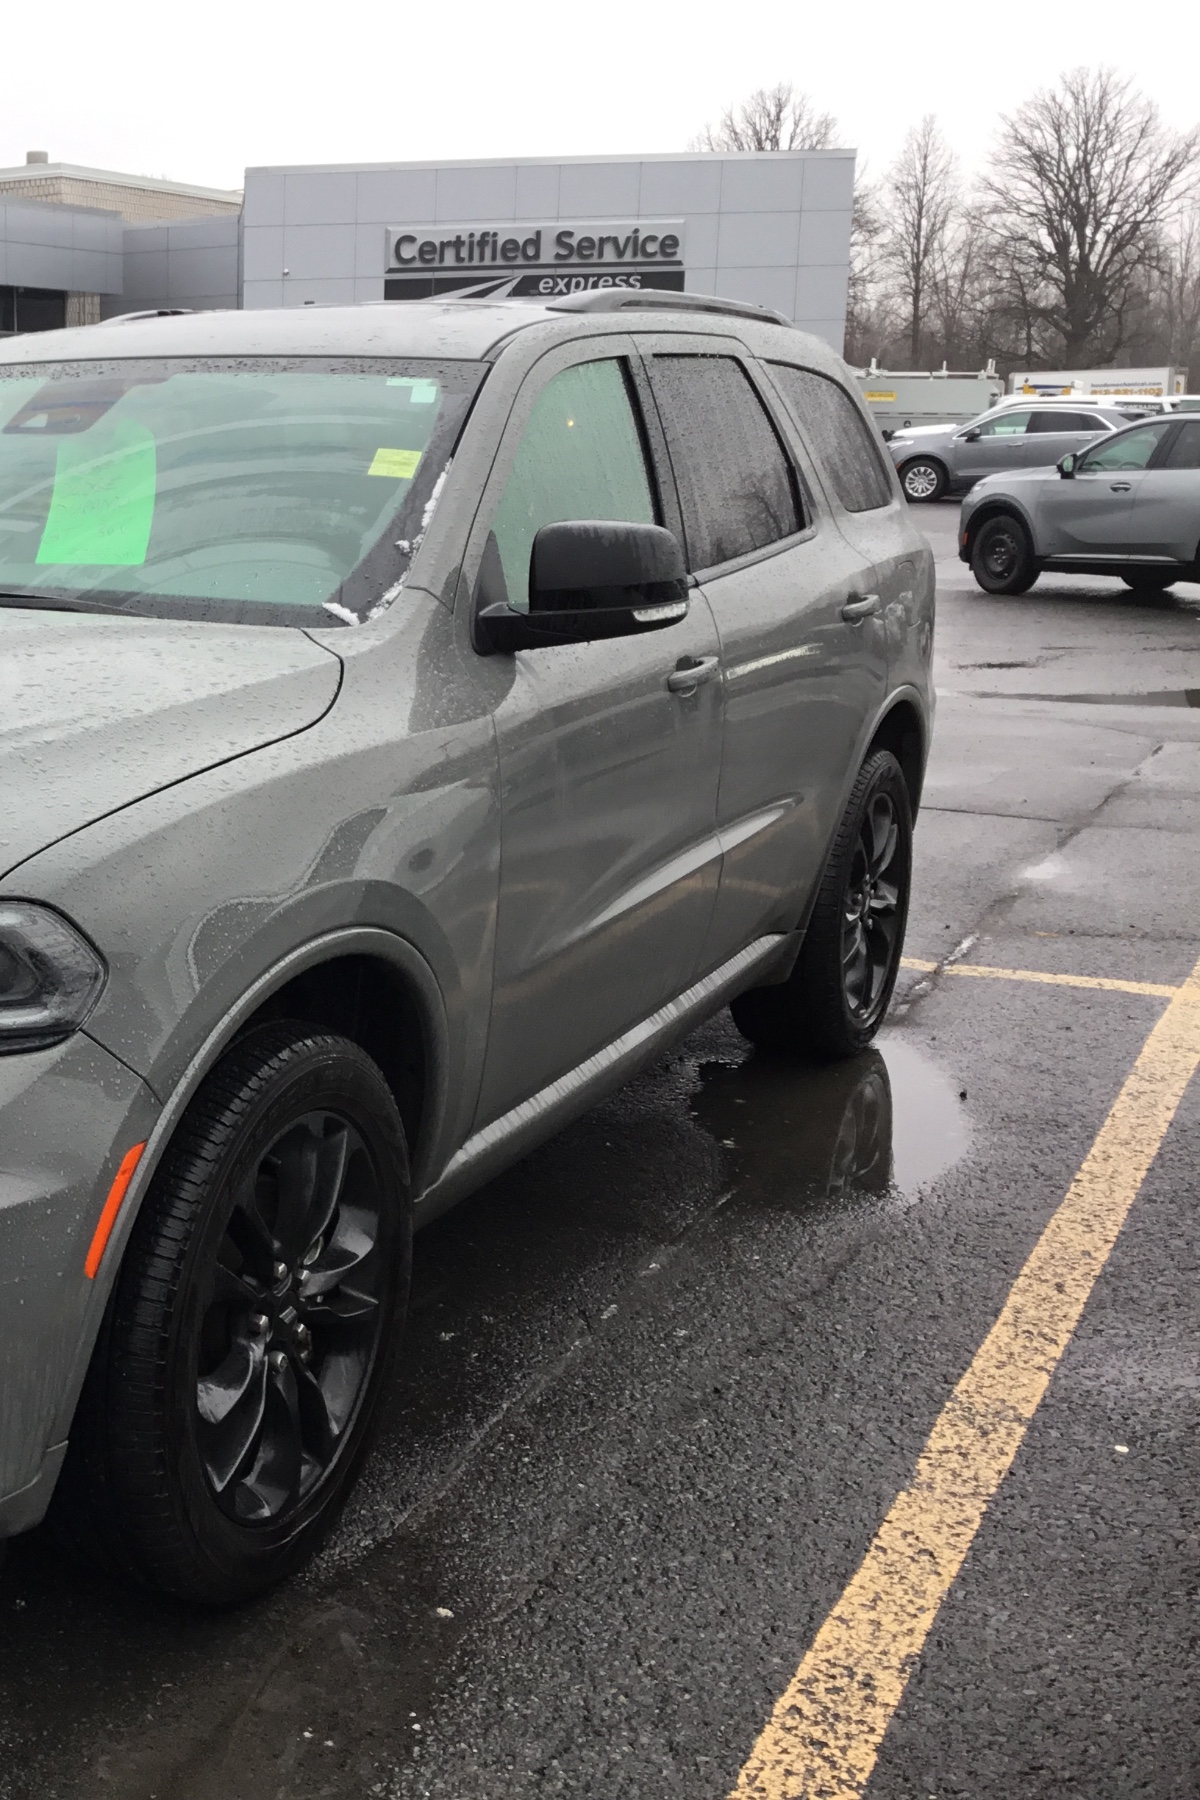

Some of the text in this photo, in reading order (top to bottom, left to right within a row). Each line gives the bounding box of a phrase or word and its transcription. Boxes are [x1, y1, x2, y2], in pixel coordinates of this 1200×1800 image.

[395, 228, 680, 264] Certified Service
[539, 275, 642, 294] express
